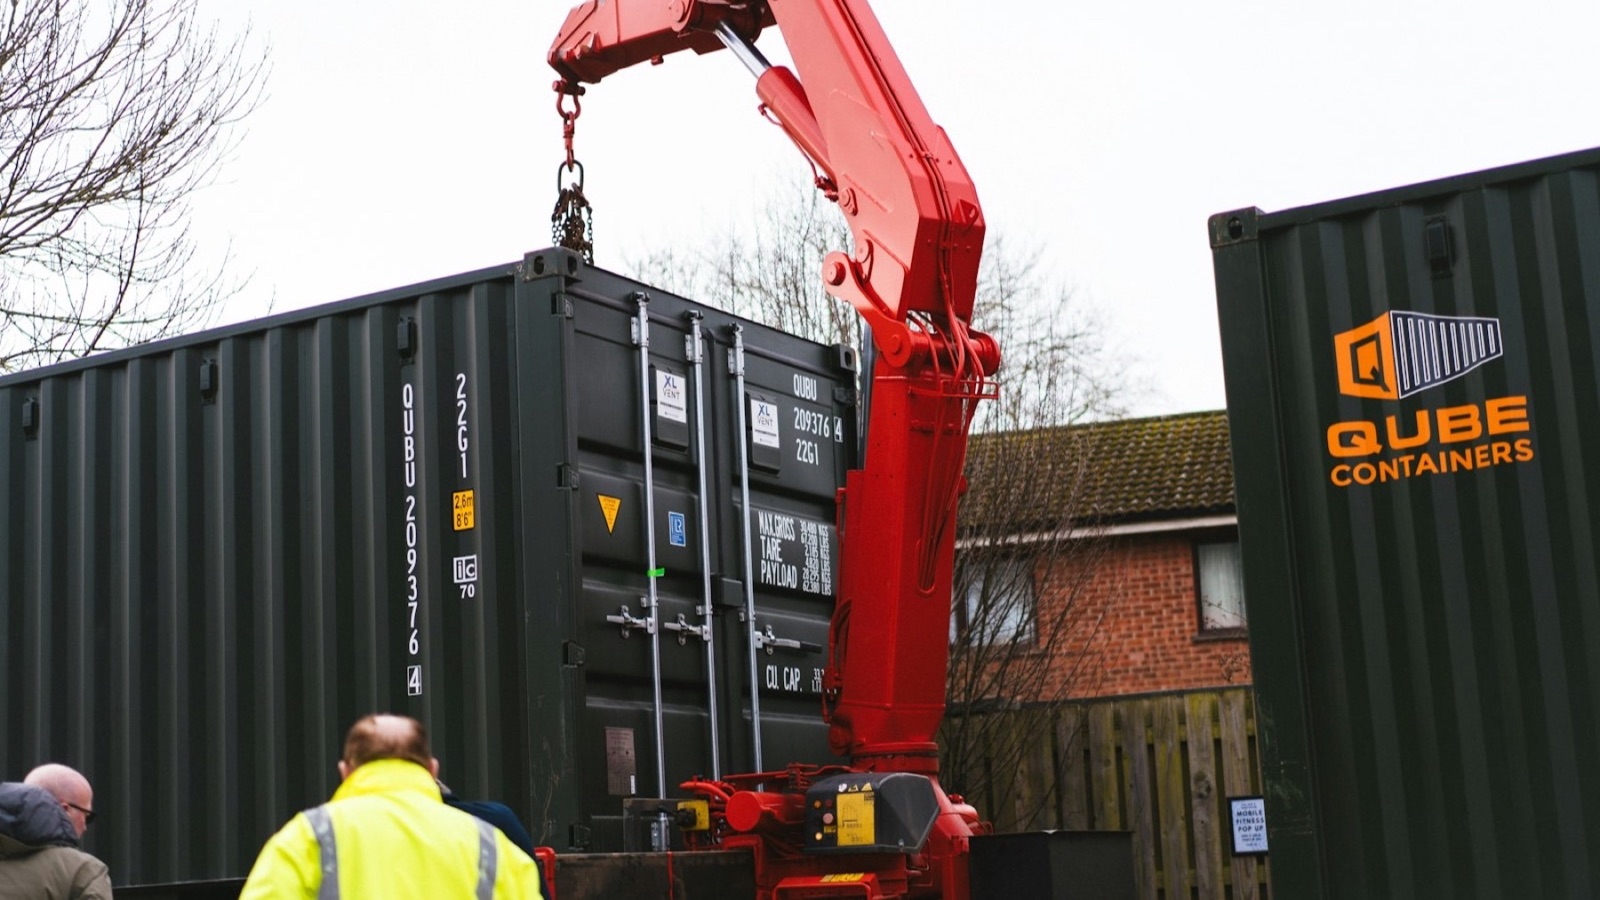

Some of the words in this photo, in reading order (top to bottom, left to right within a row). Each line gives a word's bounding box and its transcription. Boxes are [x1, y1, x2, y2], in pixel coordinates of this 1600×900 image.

[663, 387, 680, 399] VENT
[664, 374, 677, 389] XL
[793, 374, 817, 401] QUBU
[757, 415, 773, 427] VENT
[758, 404, 770, 416] XL
[793, 407, 830, 438] 209376
[402, 383, 416, 487] QUBU
[455, 373, 468, 478] 22G1
[1327, 395, 1530, 458] QUBE
[796, 438, 819, 466] 22G1
[1330, 439, 1534, 487] CONTAINERS
[760, 535, 783, 562] TARE
[405, 496, 419, 655] 209376
[761, 559, 798, 589] PAYLOAD
[459, 584, 475, 599] 70
[408, 666, 421, 694] 4
[766, 664, 779, 690] CU.
[783, 666, 803, 692] CAP.
[1235, 817, 1264, 825] FITNESS
